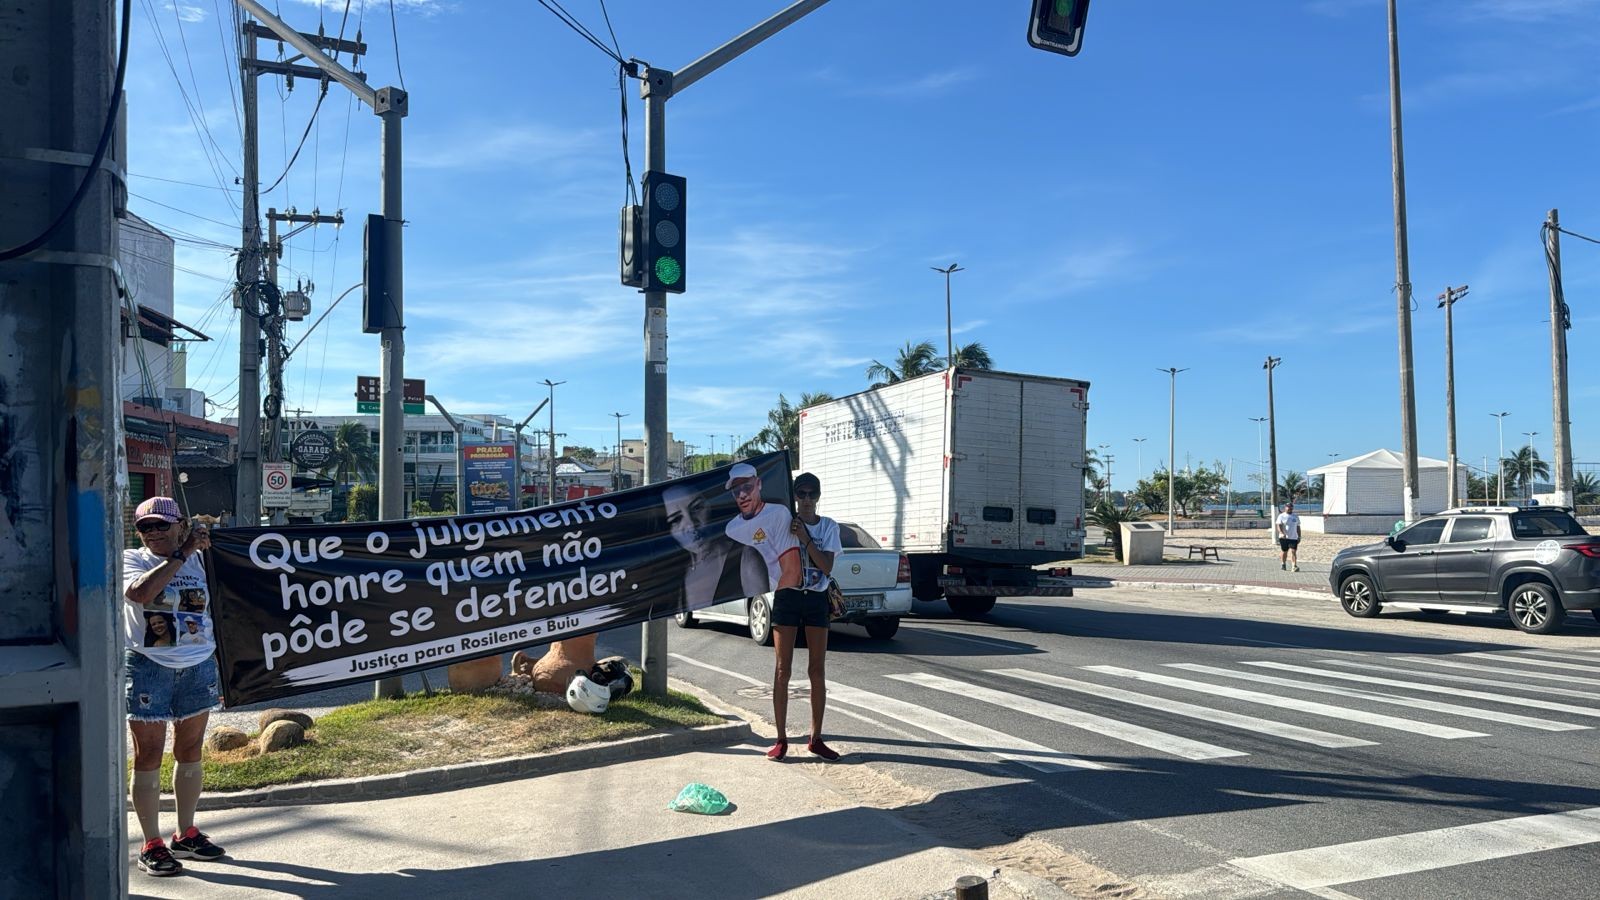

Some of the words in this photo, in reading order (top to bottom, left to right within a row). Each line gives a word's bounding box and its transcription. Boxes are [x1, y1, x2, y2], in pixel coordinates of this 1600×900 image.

[270, 475, 284, 486] 50
[298, 445, 329, 454] GARAGE
[249, 533, 343, 573] Que
[366, 531, 390, 554] o
[409, 501, 618, 559] julgamento
[279, 569, 407, 610] honre
[425, 549, 527, 595] quem
[542, 530, 602, 568] não
[262, 610, 369, 670] pôde
[389, 606, 436, 637] se
[455, 567, 639, 623] defender.
[349, 653, 409, 673] Justiça
[415, 643, 455, 664] para
[461, 628, 528, 651] Rosilene
[532, 626, 542, 635] e
[546, 616, 580, 633] Buiu
